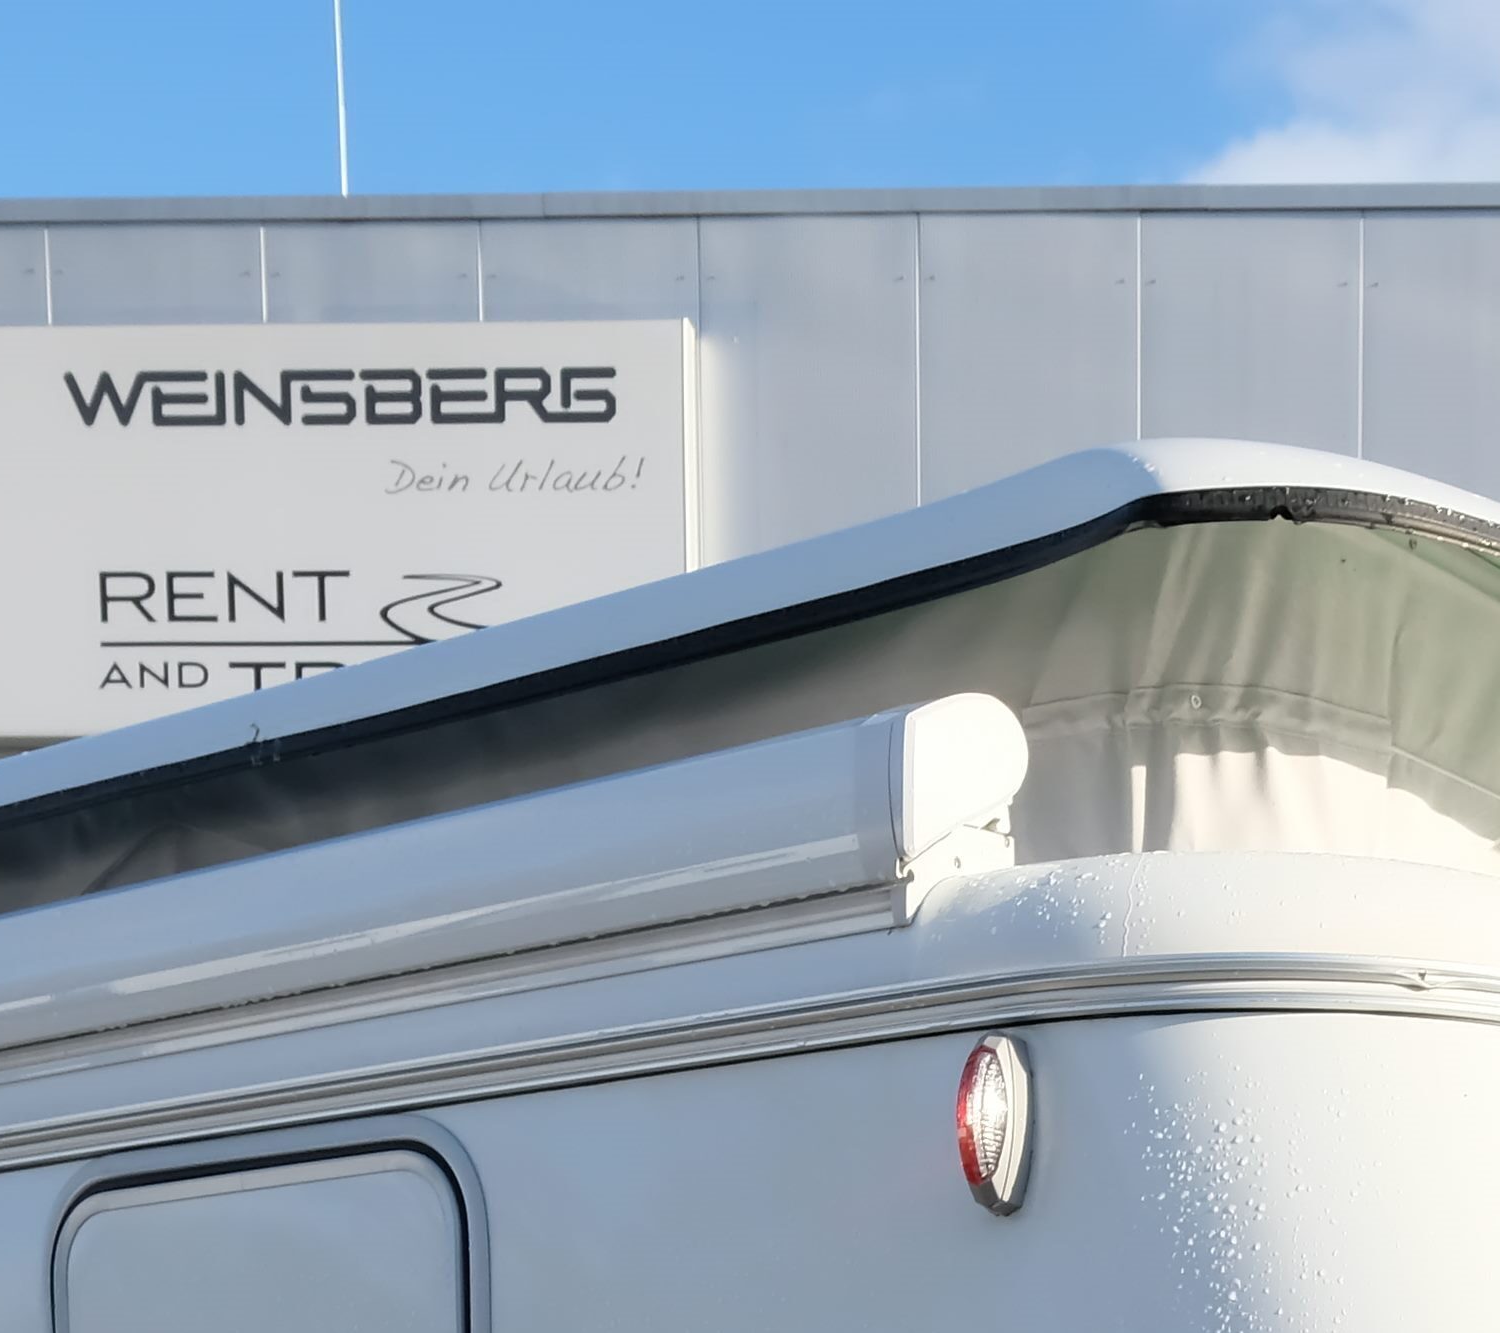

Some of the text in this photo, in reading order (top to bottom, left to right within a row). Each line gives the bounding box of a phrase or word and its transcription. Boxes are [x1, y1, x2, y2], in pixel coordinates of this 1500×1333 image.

[63, 366, 617, 427] WEINSBERG
[384, 455, 646, 495] Dein Urlaub!
[99, 570, 351, 623] RENT
[99, 660, 210, 690] AND
